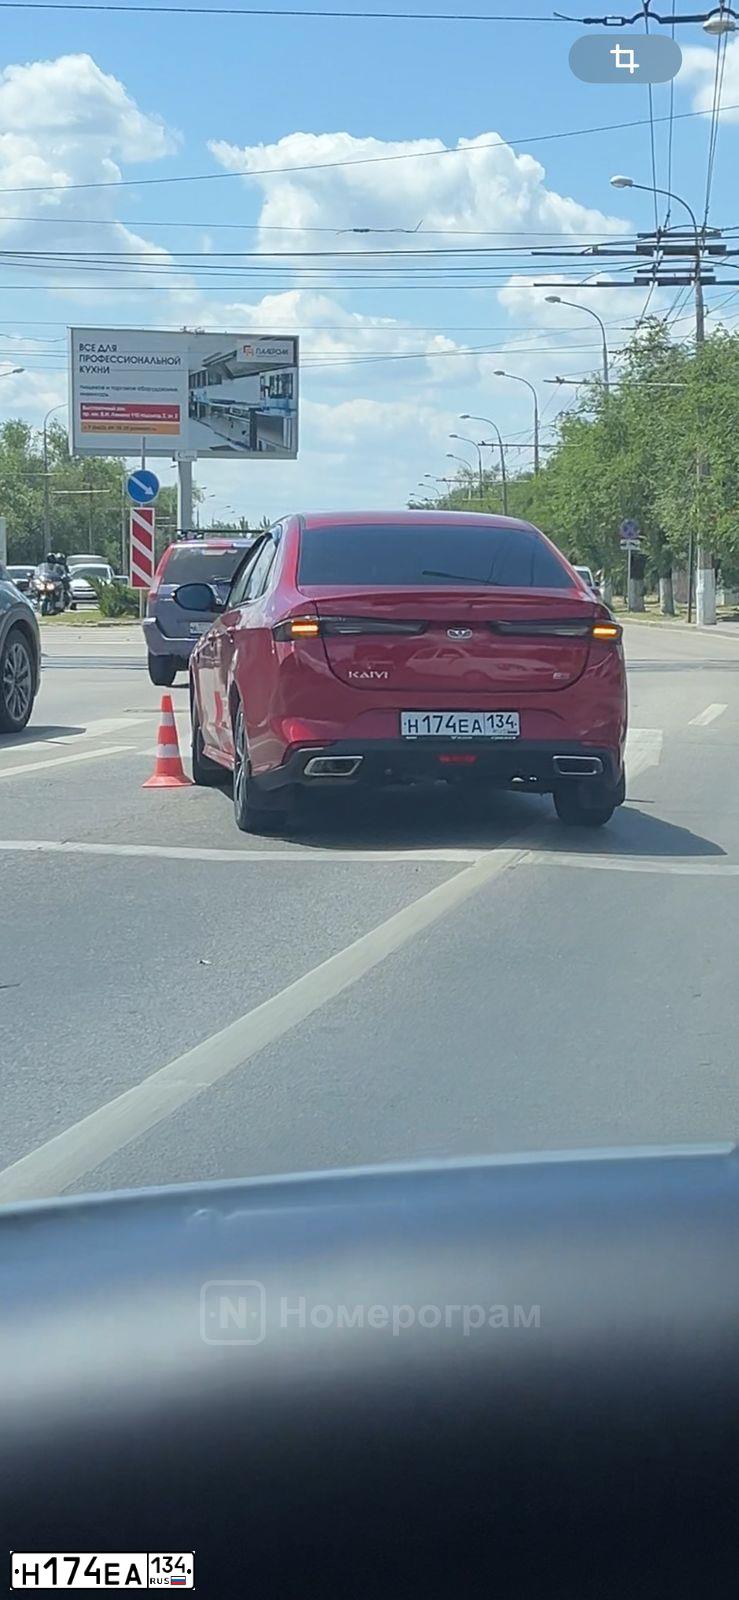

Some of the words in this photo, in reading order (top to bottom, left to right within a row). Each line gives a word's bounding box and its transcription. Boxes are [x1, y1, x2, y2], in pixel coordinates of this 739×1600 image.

[79, 343, 96, 352] ВСЕ
[98, 344, 117, 353] ДЛЯ
[79, 354, 181, 365] ПРОФЕССИОНАЛЬНОЙ
[79, 366, 110, 374] КУХНИ
[407, 715, 482, 734] Н174ЕА
[486, 714, 514, 729] 134
